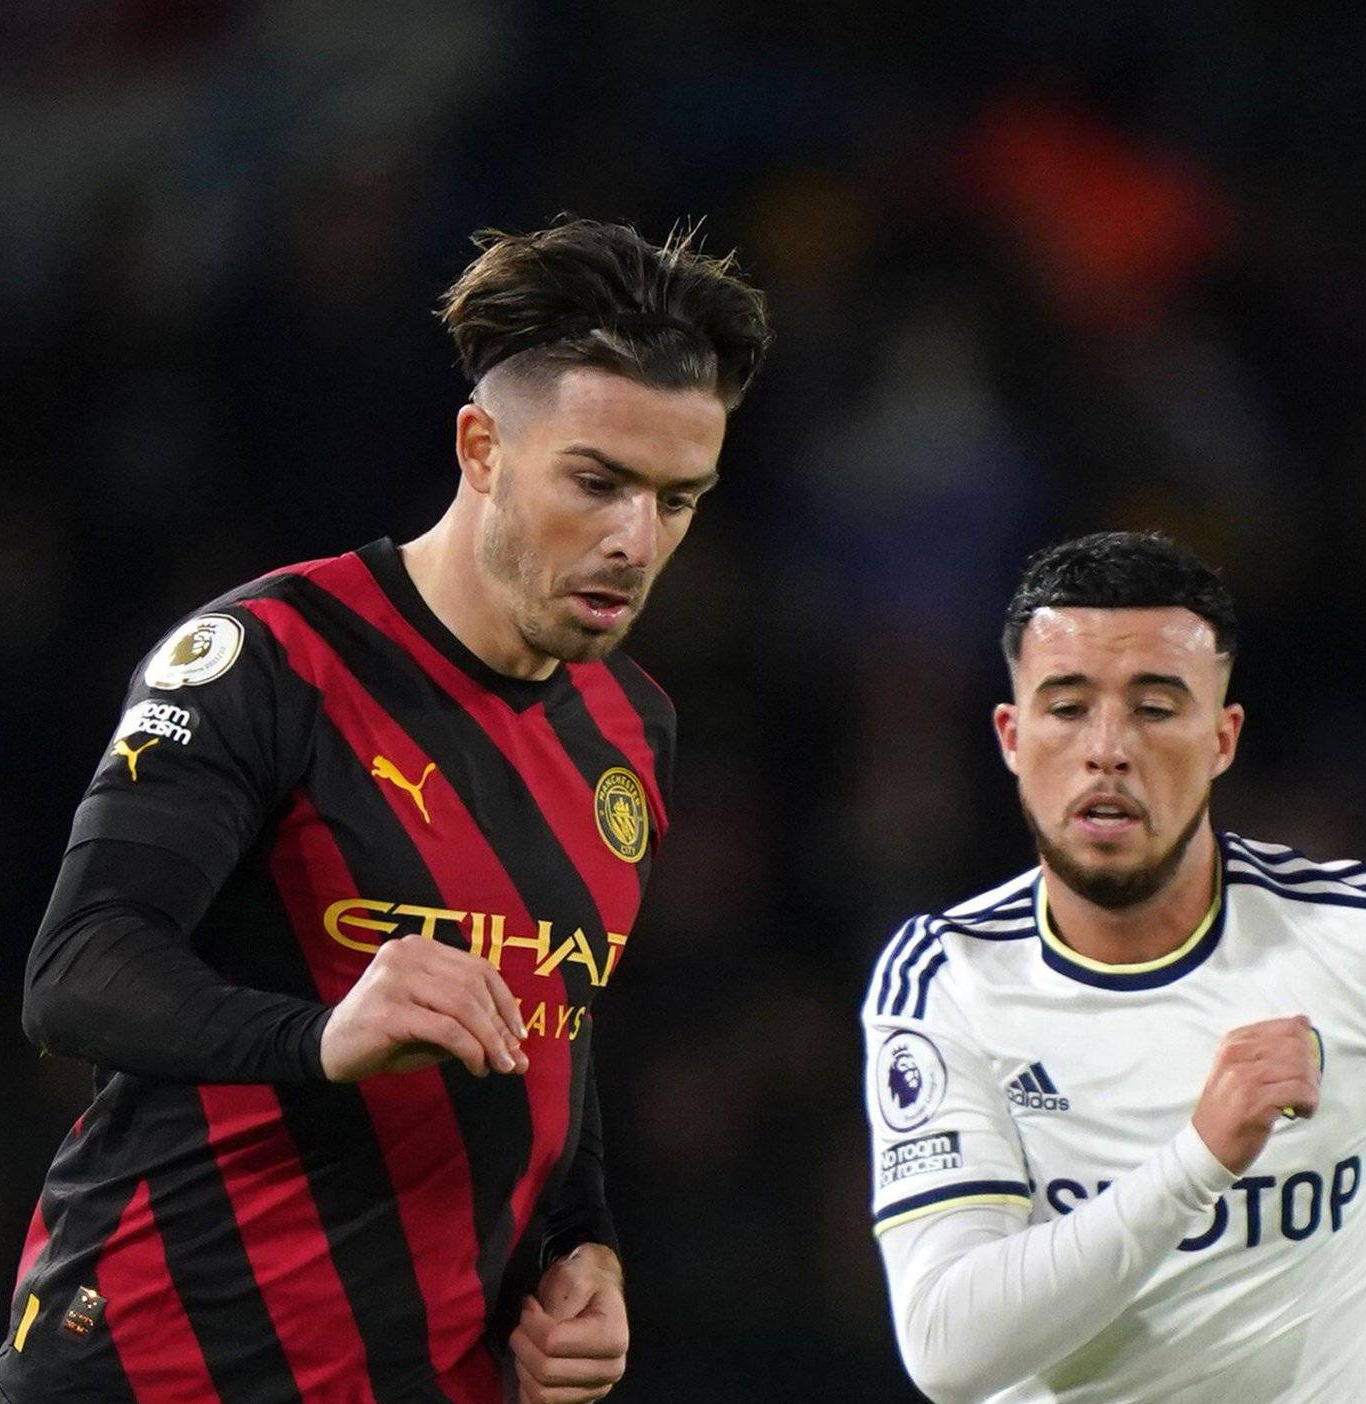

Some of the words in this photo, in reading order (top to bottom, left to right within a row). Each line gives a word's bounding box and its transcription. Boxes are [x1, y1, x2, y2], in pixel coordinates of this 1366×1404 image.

[599, 775, 642, 806] MANCHESTER
[620, 845, 636, 856] CITY
[1006, 1086, 1070, 1112] adidas
[898, 1137, 951, 1163] room
